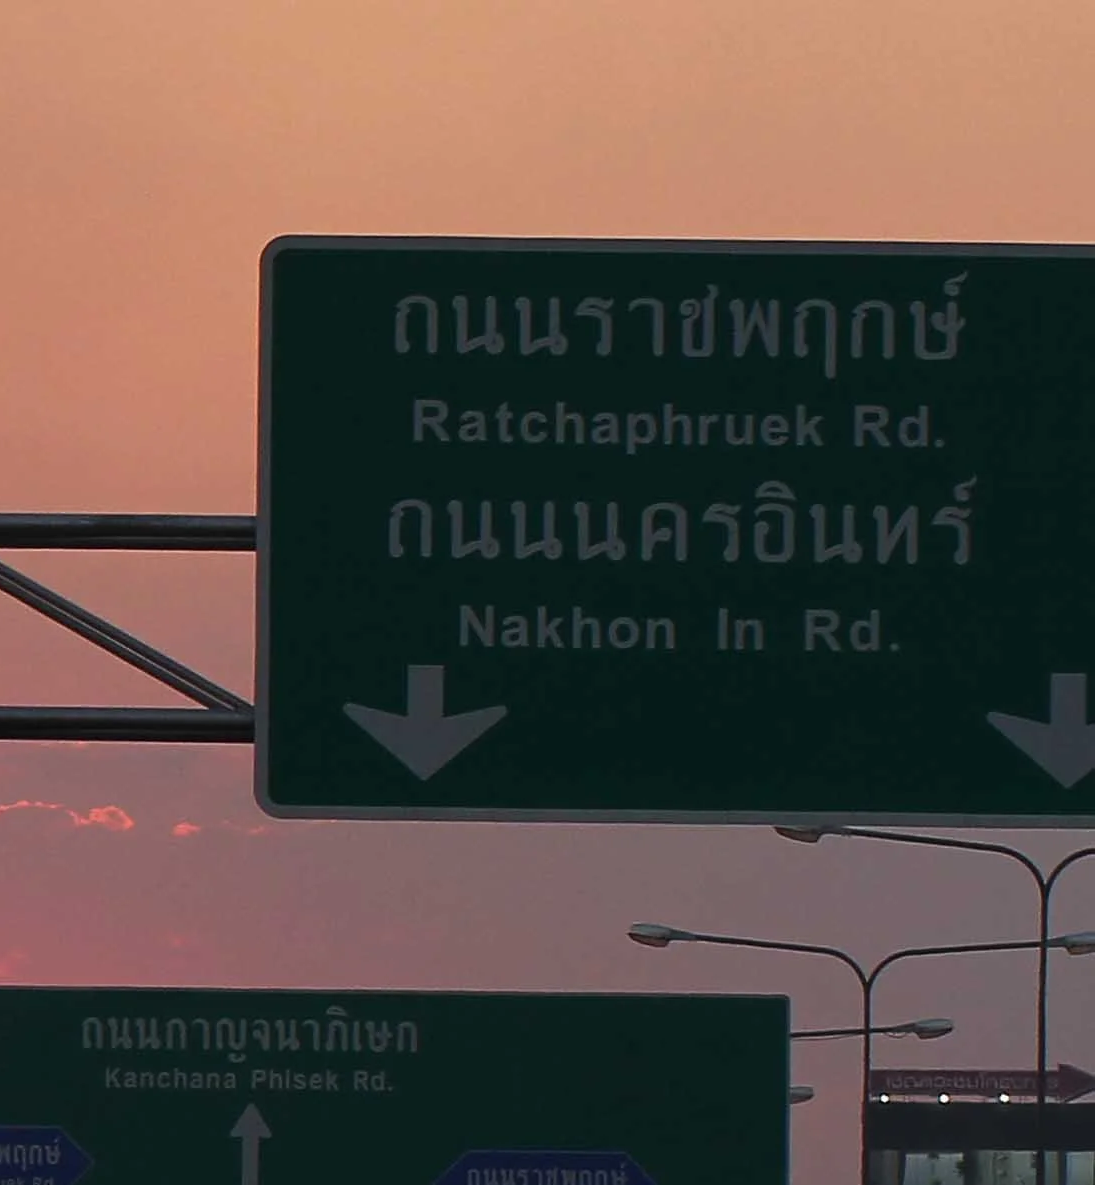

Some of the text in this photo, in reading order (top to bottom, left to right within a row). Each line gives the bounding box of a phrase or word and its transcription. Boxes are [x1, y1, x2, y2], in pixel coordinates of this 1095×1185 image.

[392, 270, 969, 379] ถนนราชพฤกษ์
[411, 398, 946, 455] Ratchaphruek Rd.
[388, 475, 978, 565] ถนนนครอินทร์
[457, 605, 901, 653] Nakhon In Rd.
[81, 1005, 419, 1062] ถนนกาญจนาภิเษก
[105, 1067, 237, 1090] Kanchana
[353, 1070, 394, 1091] Rd.
